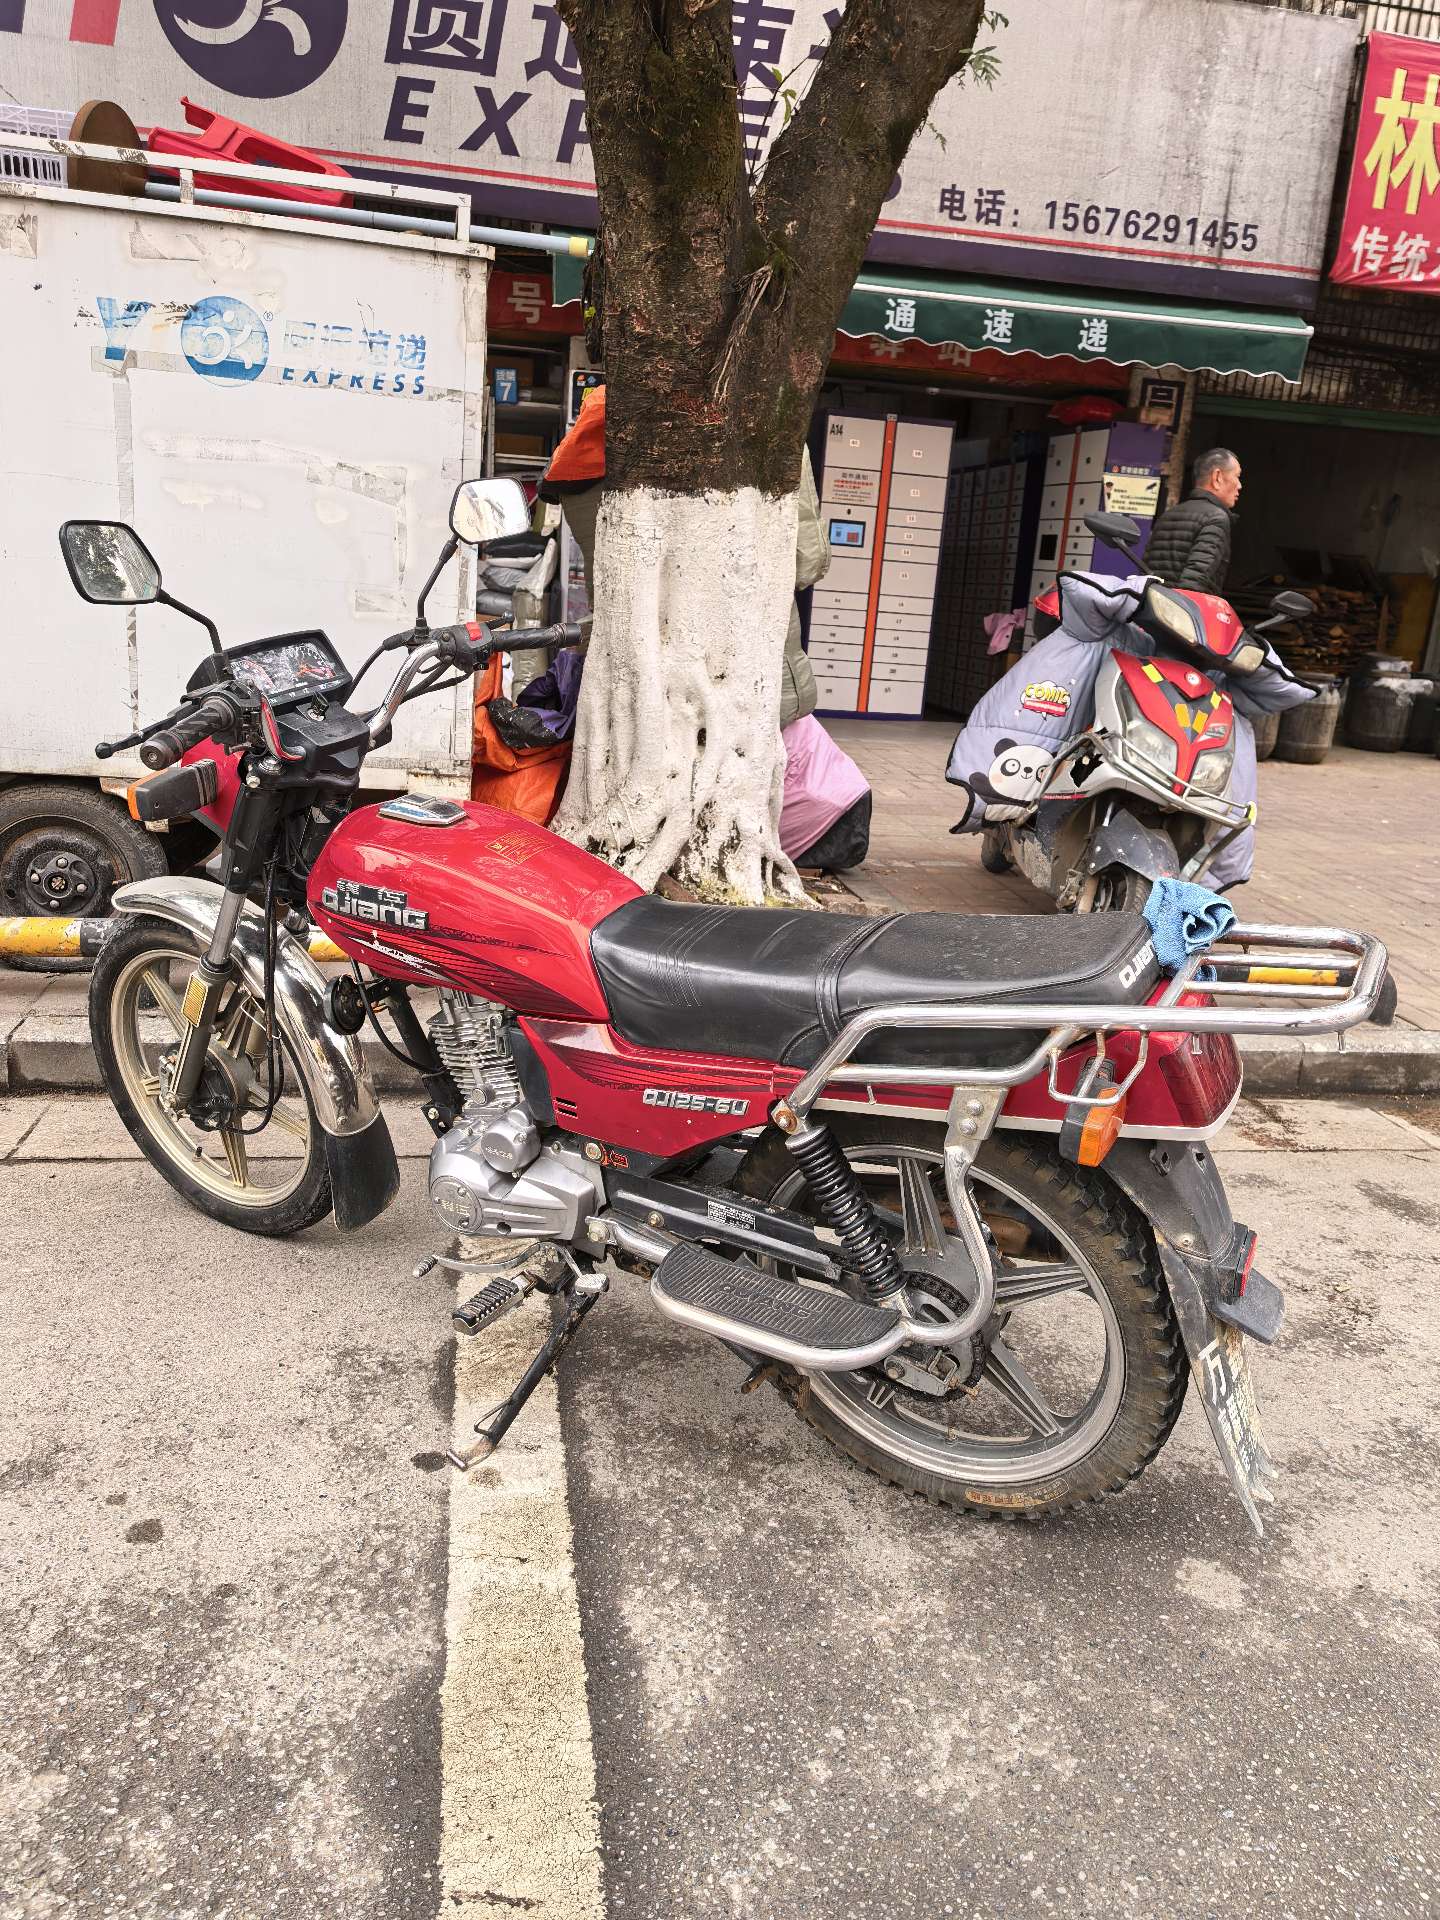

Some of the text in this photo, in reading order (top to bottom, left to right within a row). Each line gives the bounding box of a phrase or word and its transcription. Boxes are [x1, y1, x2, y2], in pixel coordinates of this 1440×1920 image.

[1044, 199, 1260, 252] 15676291455
[506, 281, 546, 324] 号
[1025, 683, 1070, 704] COMIC
